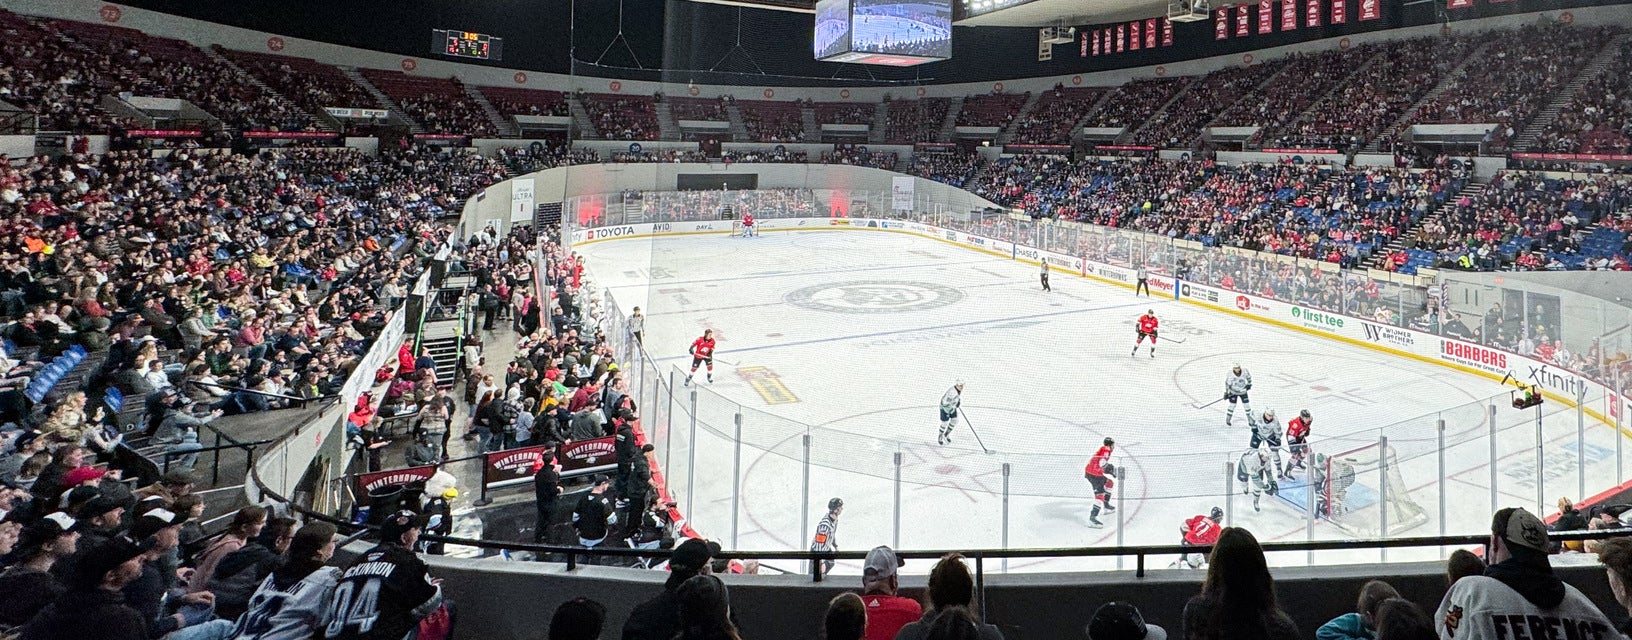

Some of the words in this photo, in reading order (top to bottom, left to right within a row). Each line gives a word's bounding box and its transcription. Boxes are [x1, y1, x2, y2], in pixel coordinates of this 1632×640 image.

[596, 226, 635, 238] TOYOTA
[1016, 248, 1032, 258] CHASE
[1303, 308, 1323, 323] first
[1325, 314, 1344, 328] tee
[566, 442, 616, 459] WINTERHAWKS
[493, 451, 540, 470] WINTERHAW
